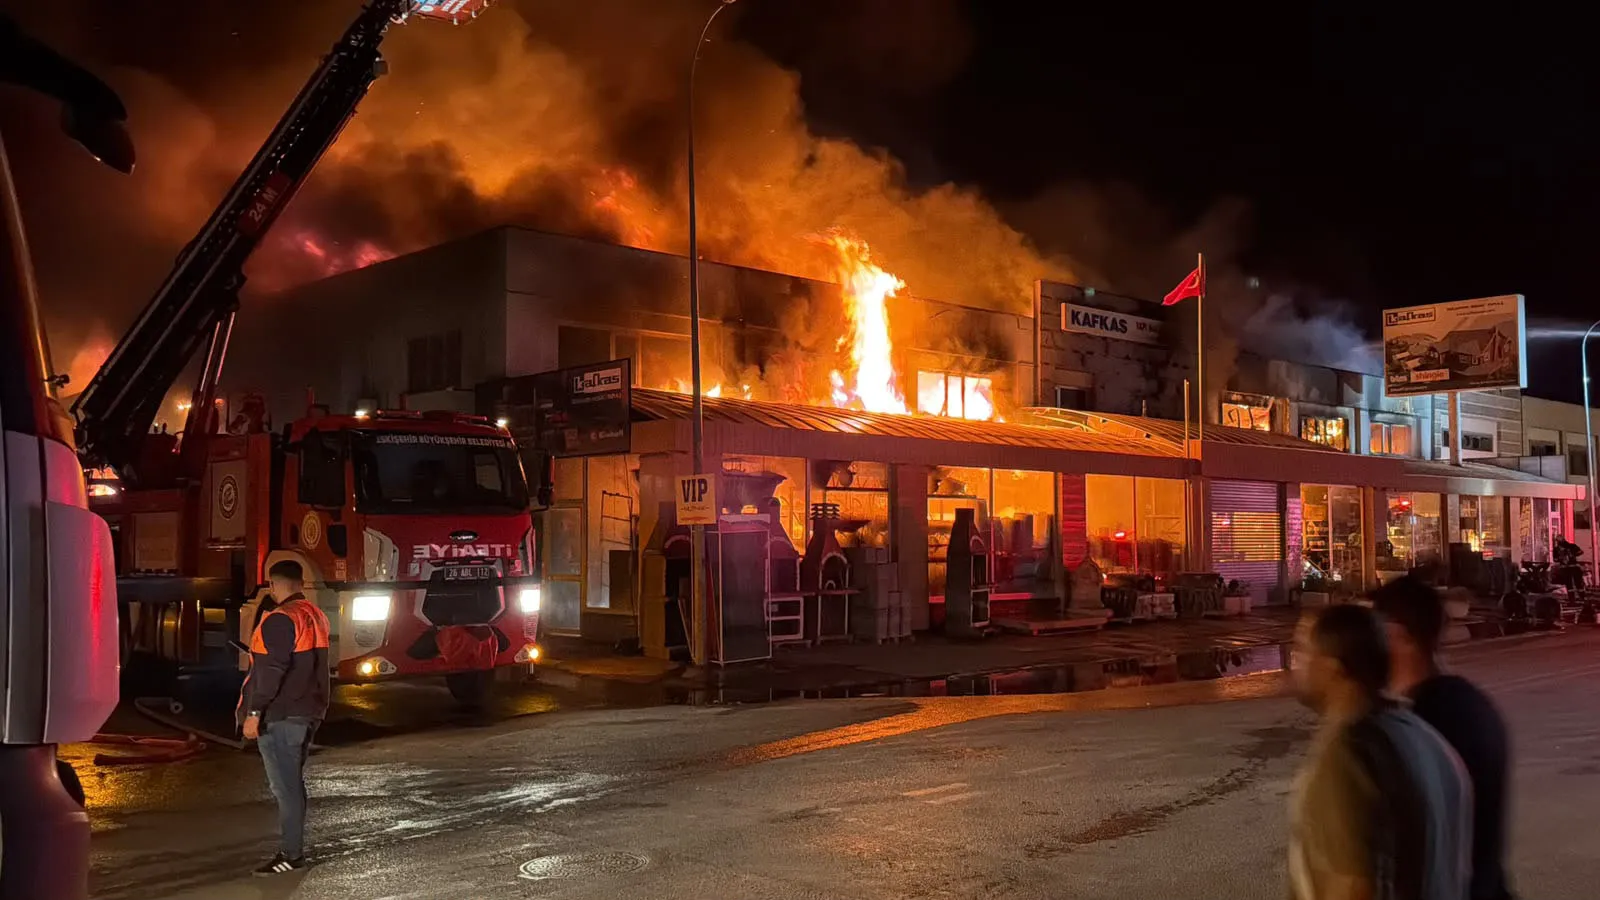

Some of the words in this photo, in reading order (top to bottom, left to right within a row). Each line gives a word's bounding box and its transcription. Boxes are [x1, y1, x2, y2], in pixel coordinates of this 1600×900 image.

[249, 202, 266, 222] 24
[1071, 309, 1128, 334] KAFKAS
[681, 478, 708, 503] VIP
